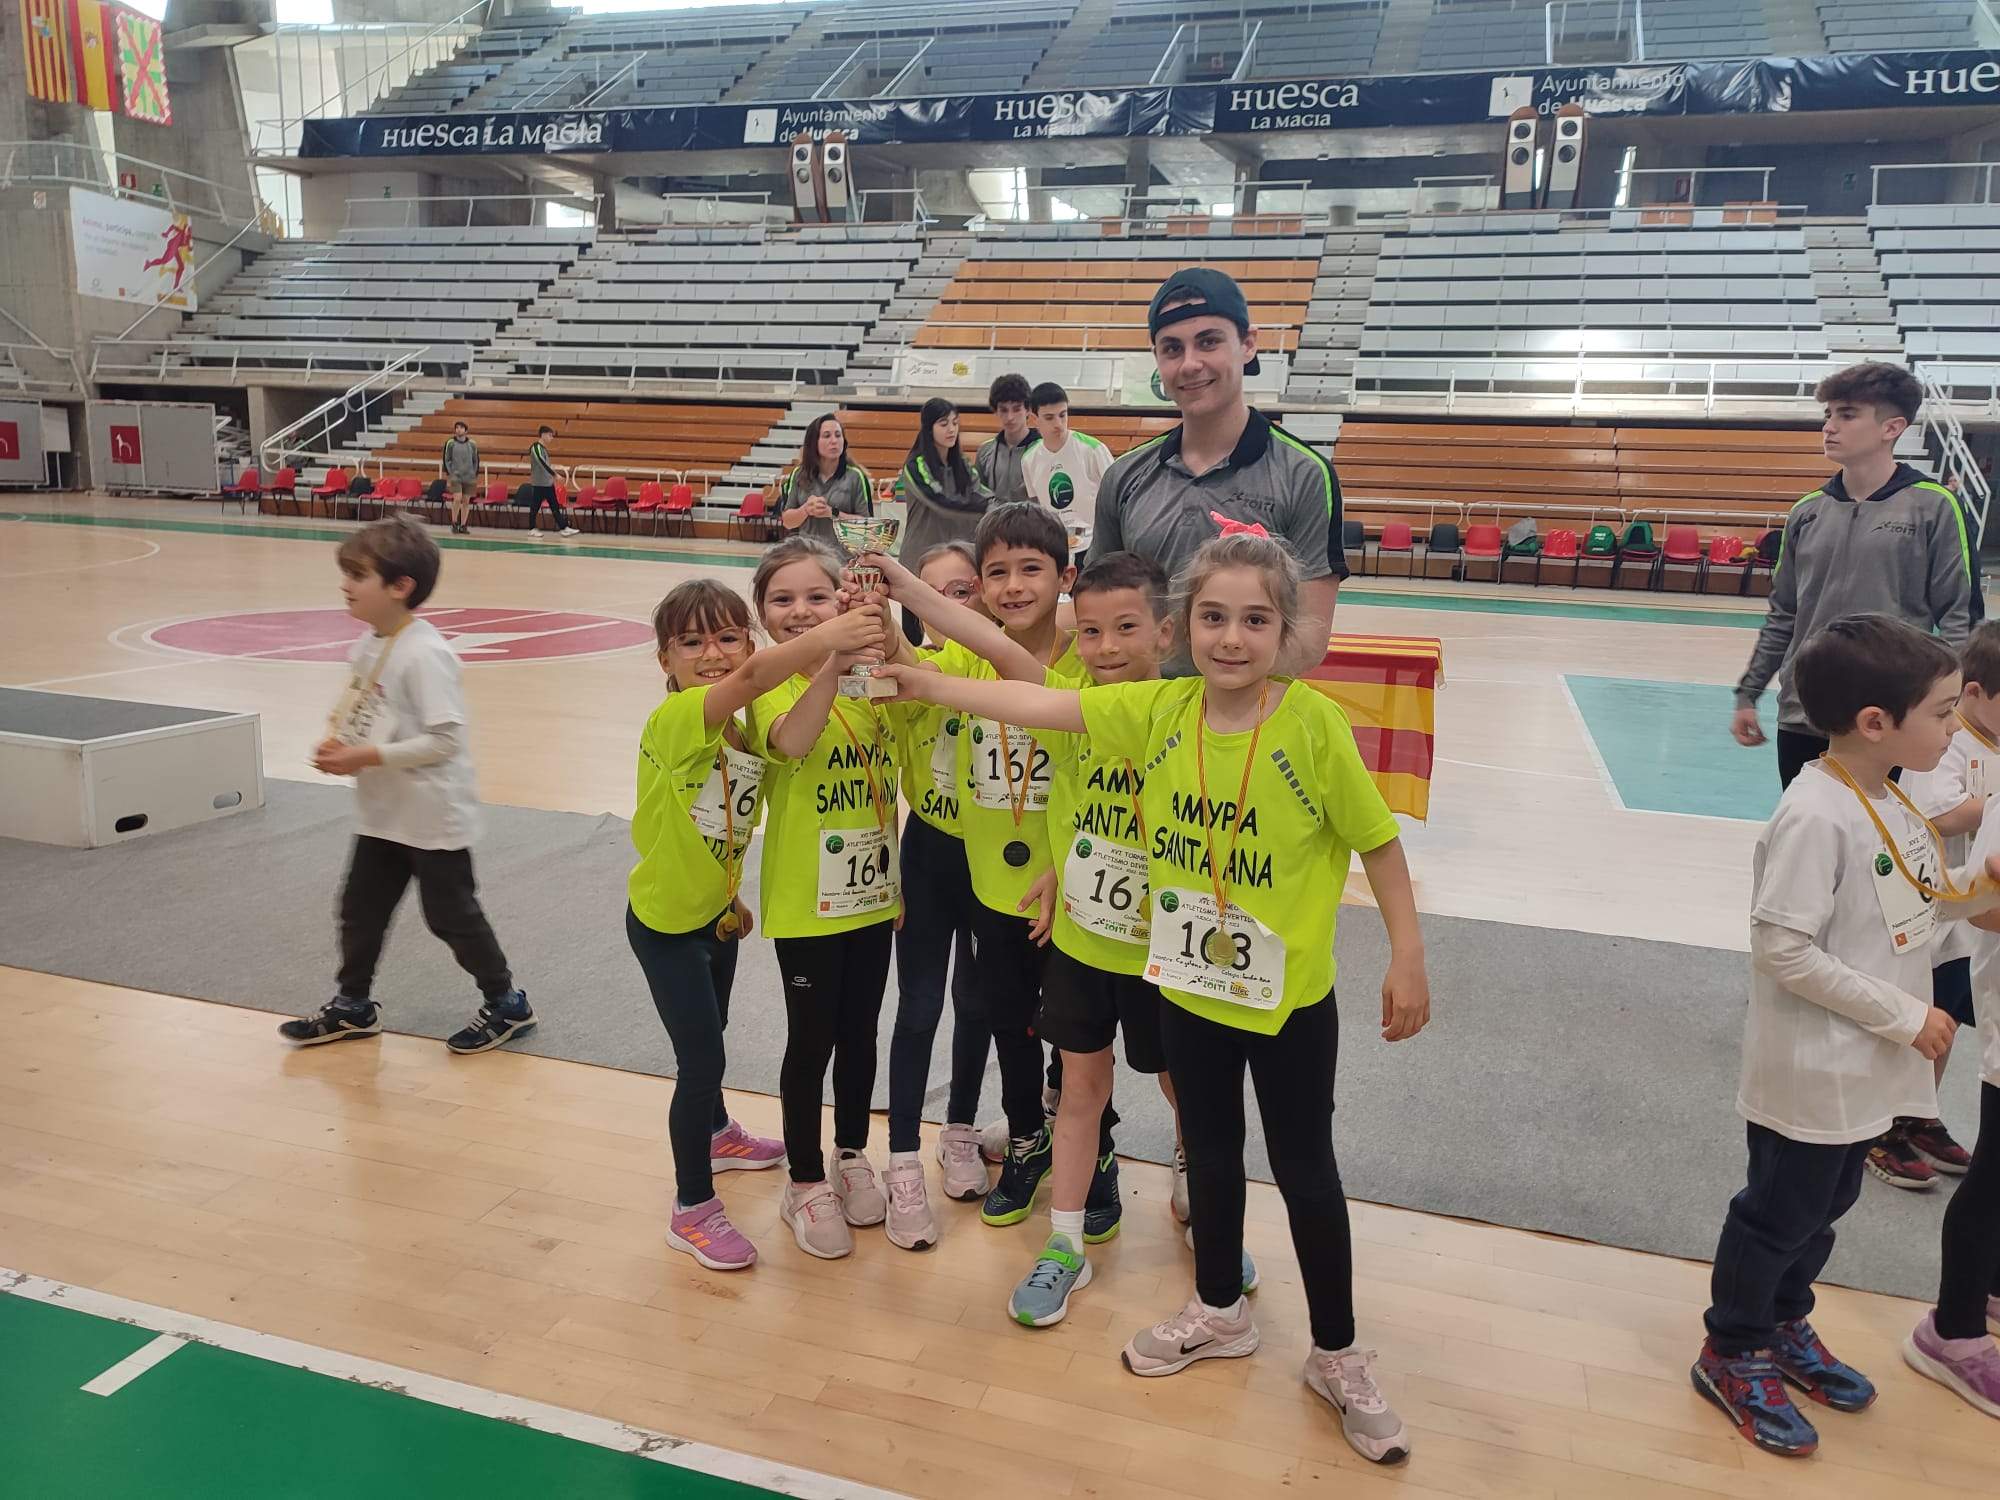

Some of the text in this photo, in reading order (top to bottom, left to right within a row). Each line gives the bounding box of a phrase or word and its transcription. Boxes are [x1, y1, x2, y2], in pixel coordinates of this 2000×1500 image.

[1540, 72, 1686, 95] Ayuntamiento
[782, 109, 888, 127] Ayuntamiento
[1538, 98, 1561, 115] de
[779, 126, 860, 143] de Huca
[988, 747, 1050, 783] 162
[1087, 766, 1145, 796] AMY
[816, 779, 875, 814] SANTA
[1172, 791, 1258, 837] AMYPA
[1093, 851, 1128, 867] ATLETISMO
[1152, 826, 1272, 889] SANTA ANA
[846, 852, 887, 887] 16
[1181, 903, 1256, 924] ATLETISMO IVERTID
[1211, 900, 1240, 911] TNEO
